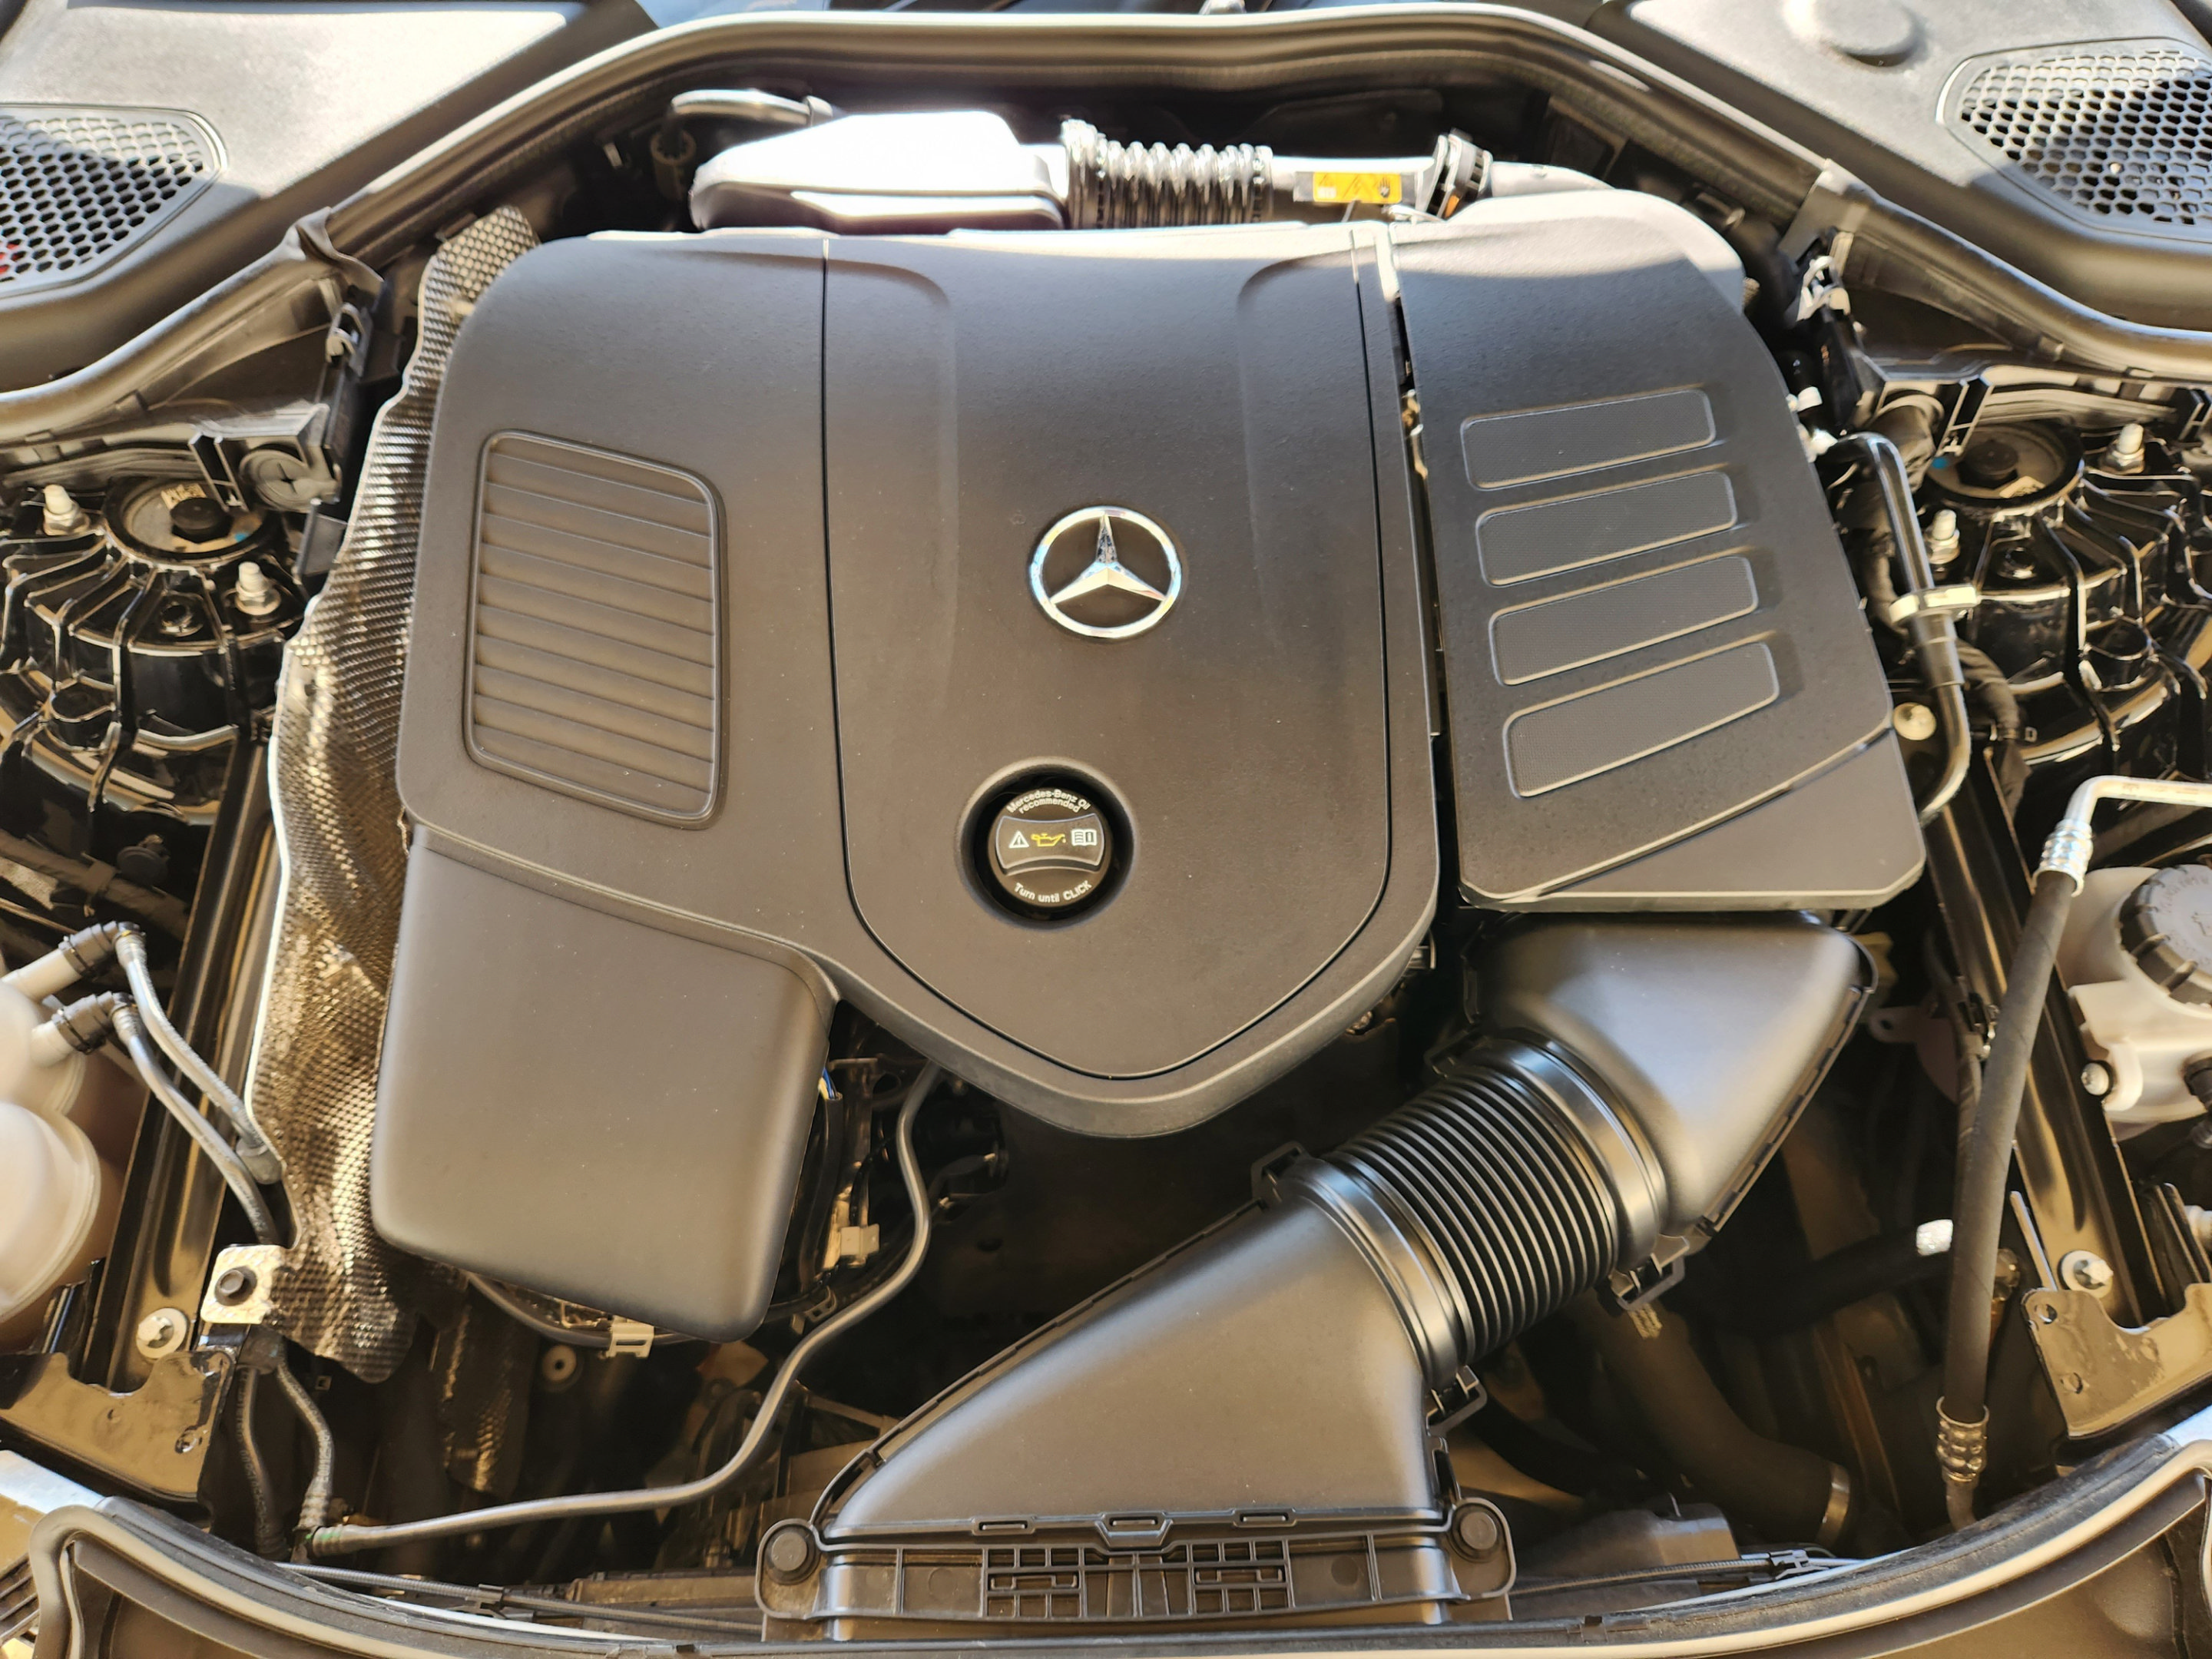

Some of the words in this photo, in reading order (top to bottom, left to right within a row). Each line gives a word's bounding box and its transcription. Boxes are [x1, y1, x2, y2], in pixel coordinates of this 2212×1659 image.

[1006, 789, 1078, 813] Mercedes-Benz
[1078, 799, 1091, 810] Oil
[1018, 798, 1081, 814] recommended
[1015, 882, 1035, 900] Turn
[1038, 892, 1060, 903] until
[1062, 879, 1092, 901] CLICK
